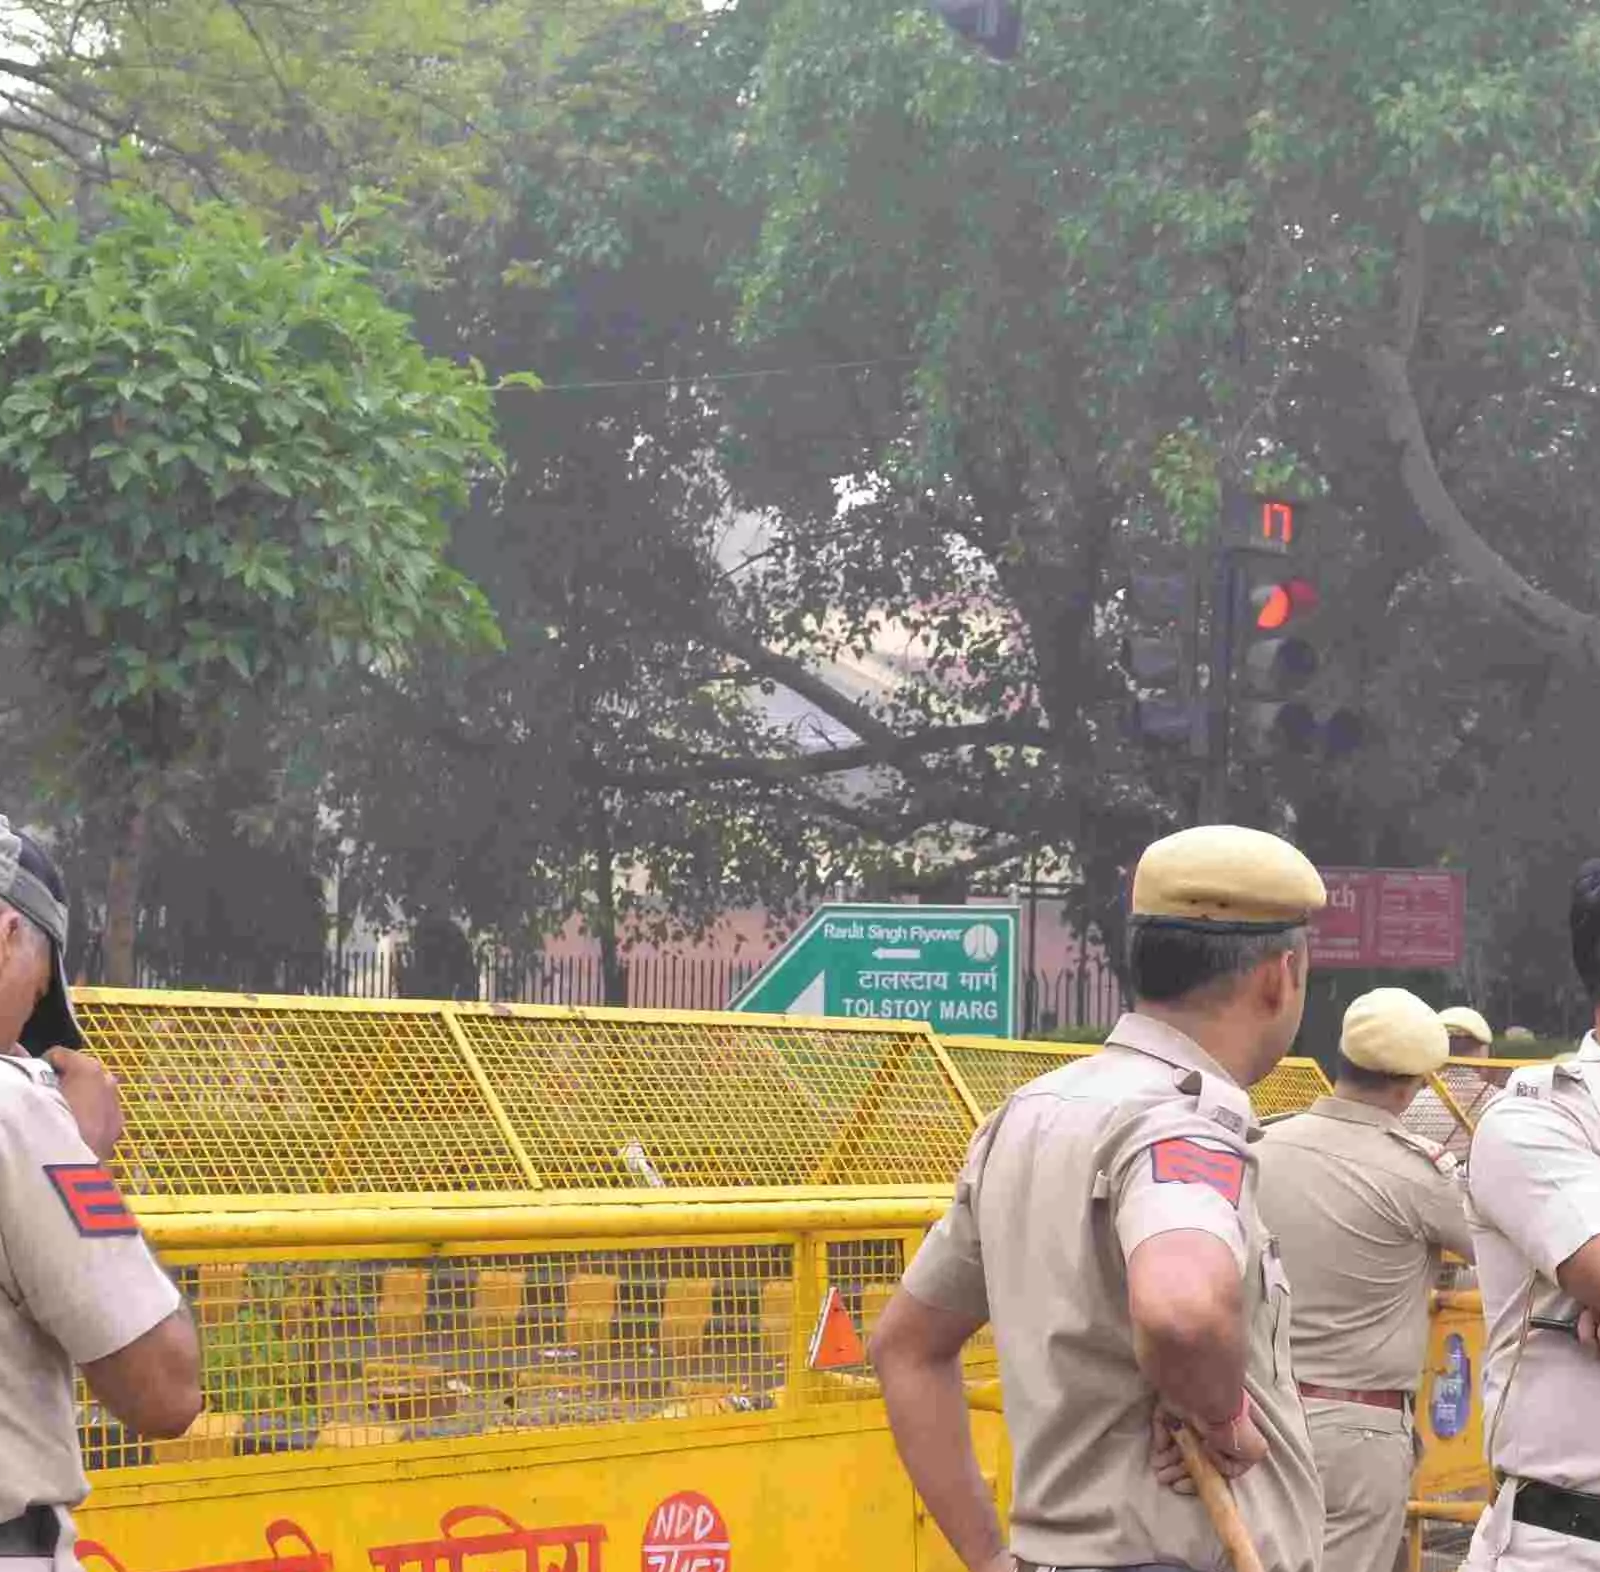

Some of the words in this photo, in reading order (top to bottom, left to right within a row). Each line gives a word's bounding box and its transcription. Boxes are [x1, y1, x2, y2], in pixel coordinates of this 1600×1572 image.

[868, 925, 907, 944] Singh
[910, 926, 963, 944] Flyover
[857, 970, 949, 990] टालस्टाय
[958, 965, 998, 992] मार्ग
[841, 998, 933, 1018] TOLSTOY
[940, 1000, 998, 1019] MARG
[653, 1501, 715, 1542] NDD
